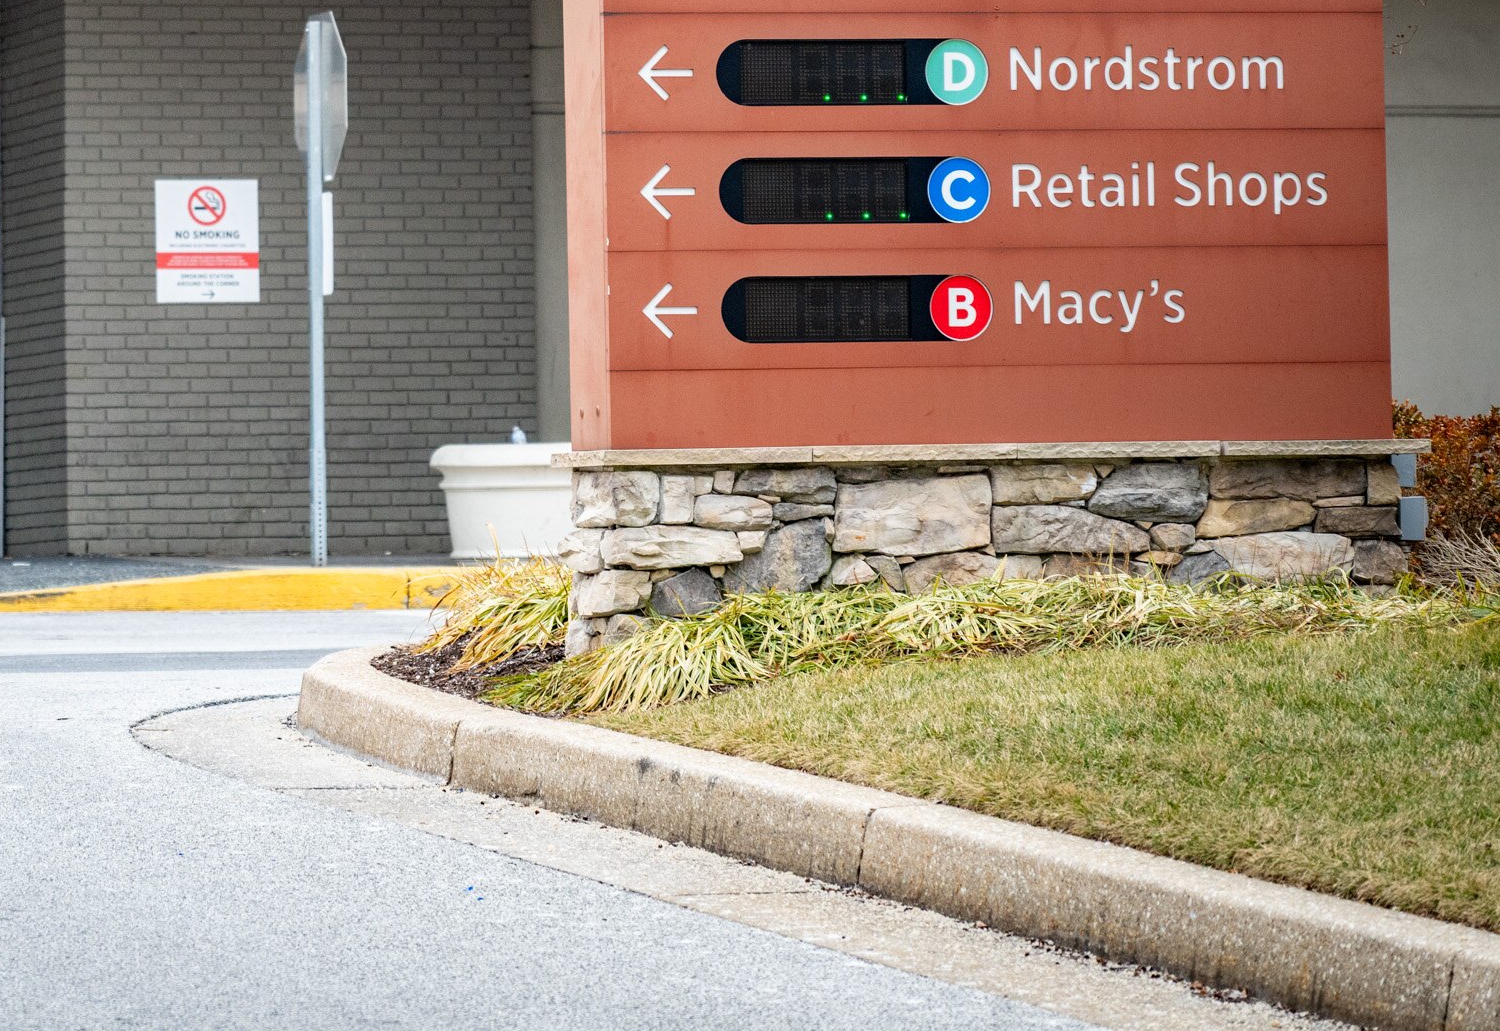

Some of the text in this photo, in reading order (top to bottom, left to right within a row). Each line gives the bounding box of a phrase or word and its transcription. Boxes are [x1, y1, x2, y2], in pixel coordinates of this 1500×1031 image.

[943, 45, 1285, 91] D Nordstrom
[940, 162, 1329, 214] C Retail Shops
[175, 230, 240, 239] NO SMOKING
[947, 288, 977, 328] B
